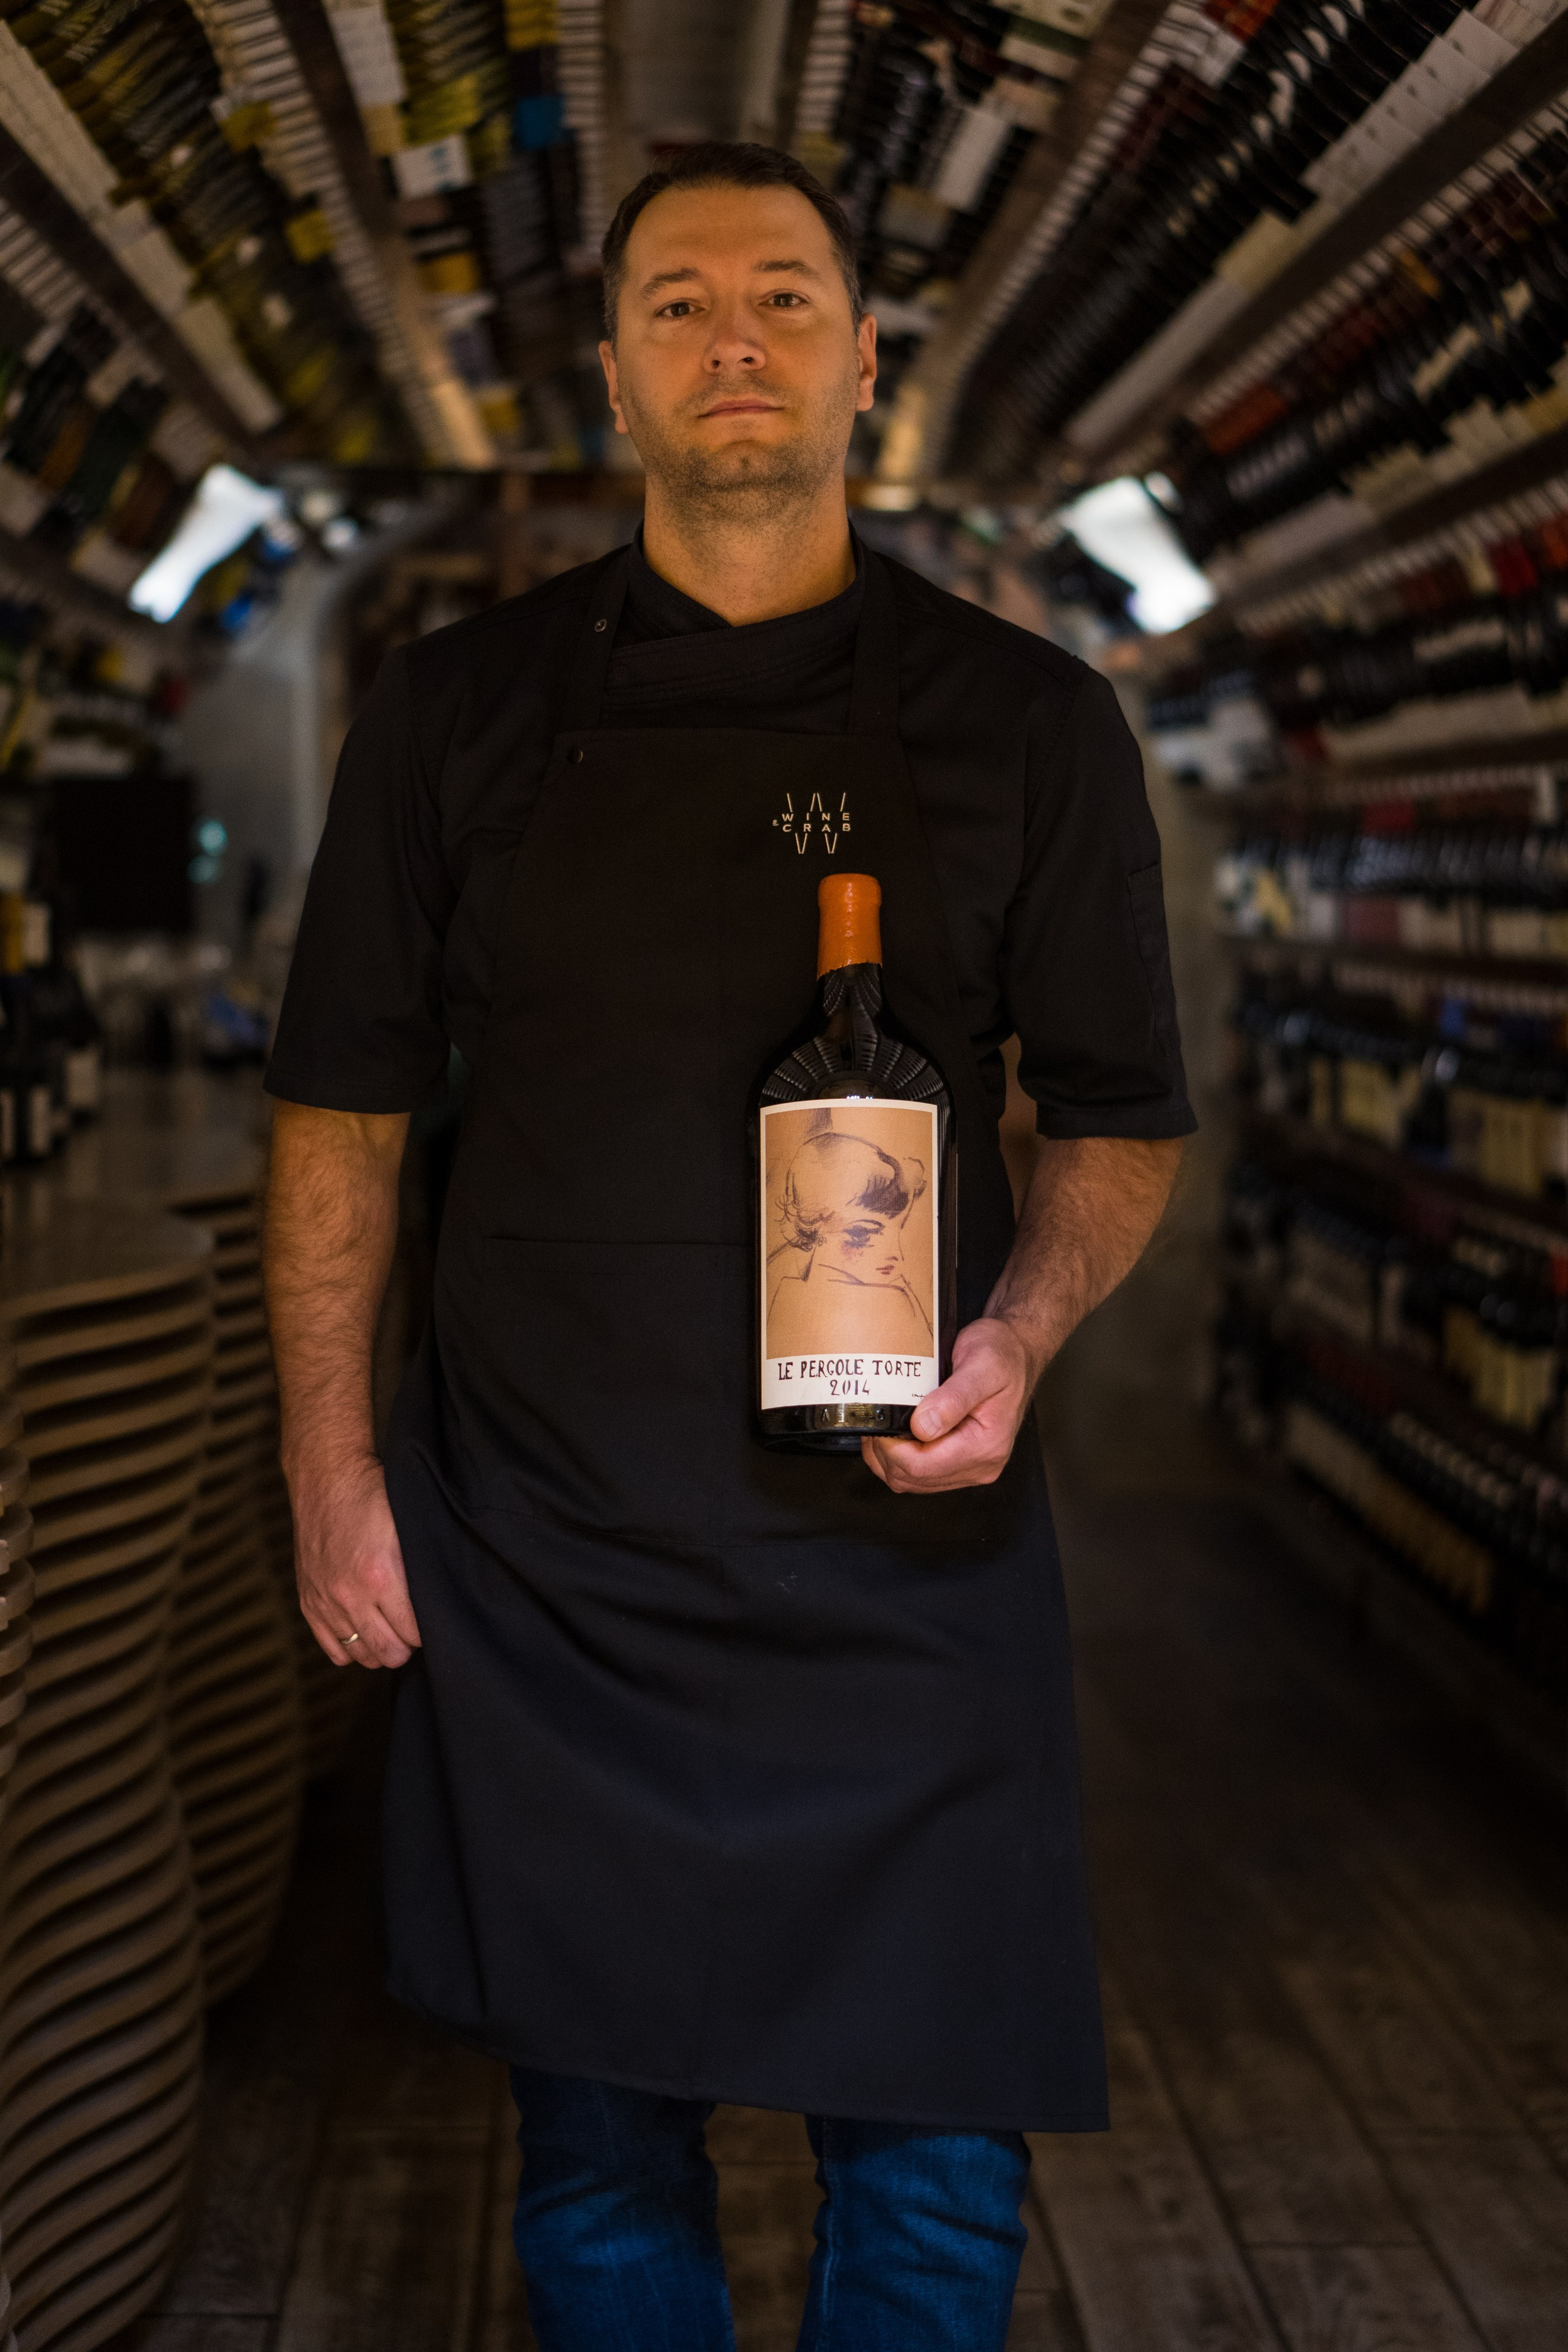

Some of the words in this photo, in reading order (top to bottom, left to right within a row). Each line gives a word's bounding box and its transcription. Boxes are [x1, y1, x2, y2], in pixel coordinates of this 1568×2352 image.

[782, 812, 850, 821] WINE
[782, 823, 851, 832] CRAB
[778, 1362, 794, 1381] LE
[801, 1359, 864, 1379] PERGOLE
[872, 1360, 921, 1377] TORTE
[830, 1379, 870, 1396] 2014
